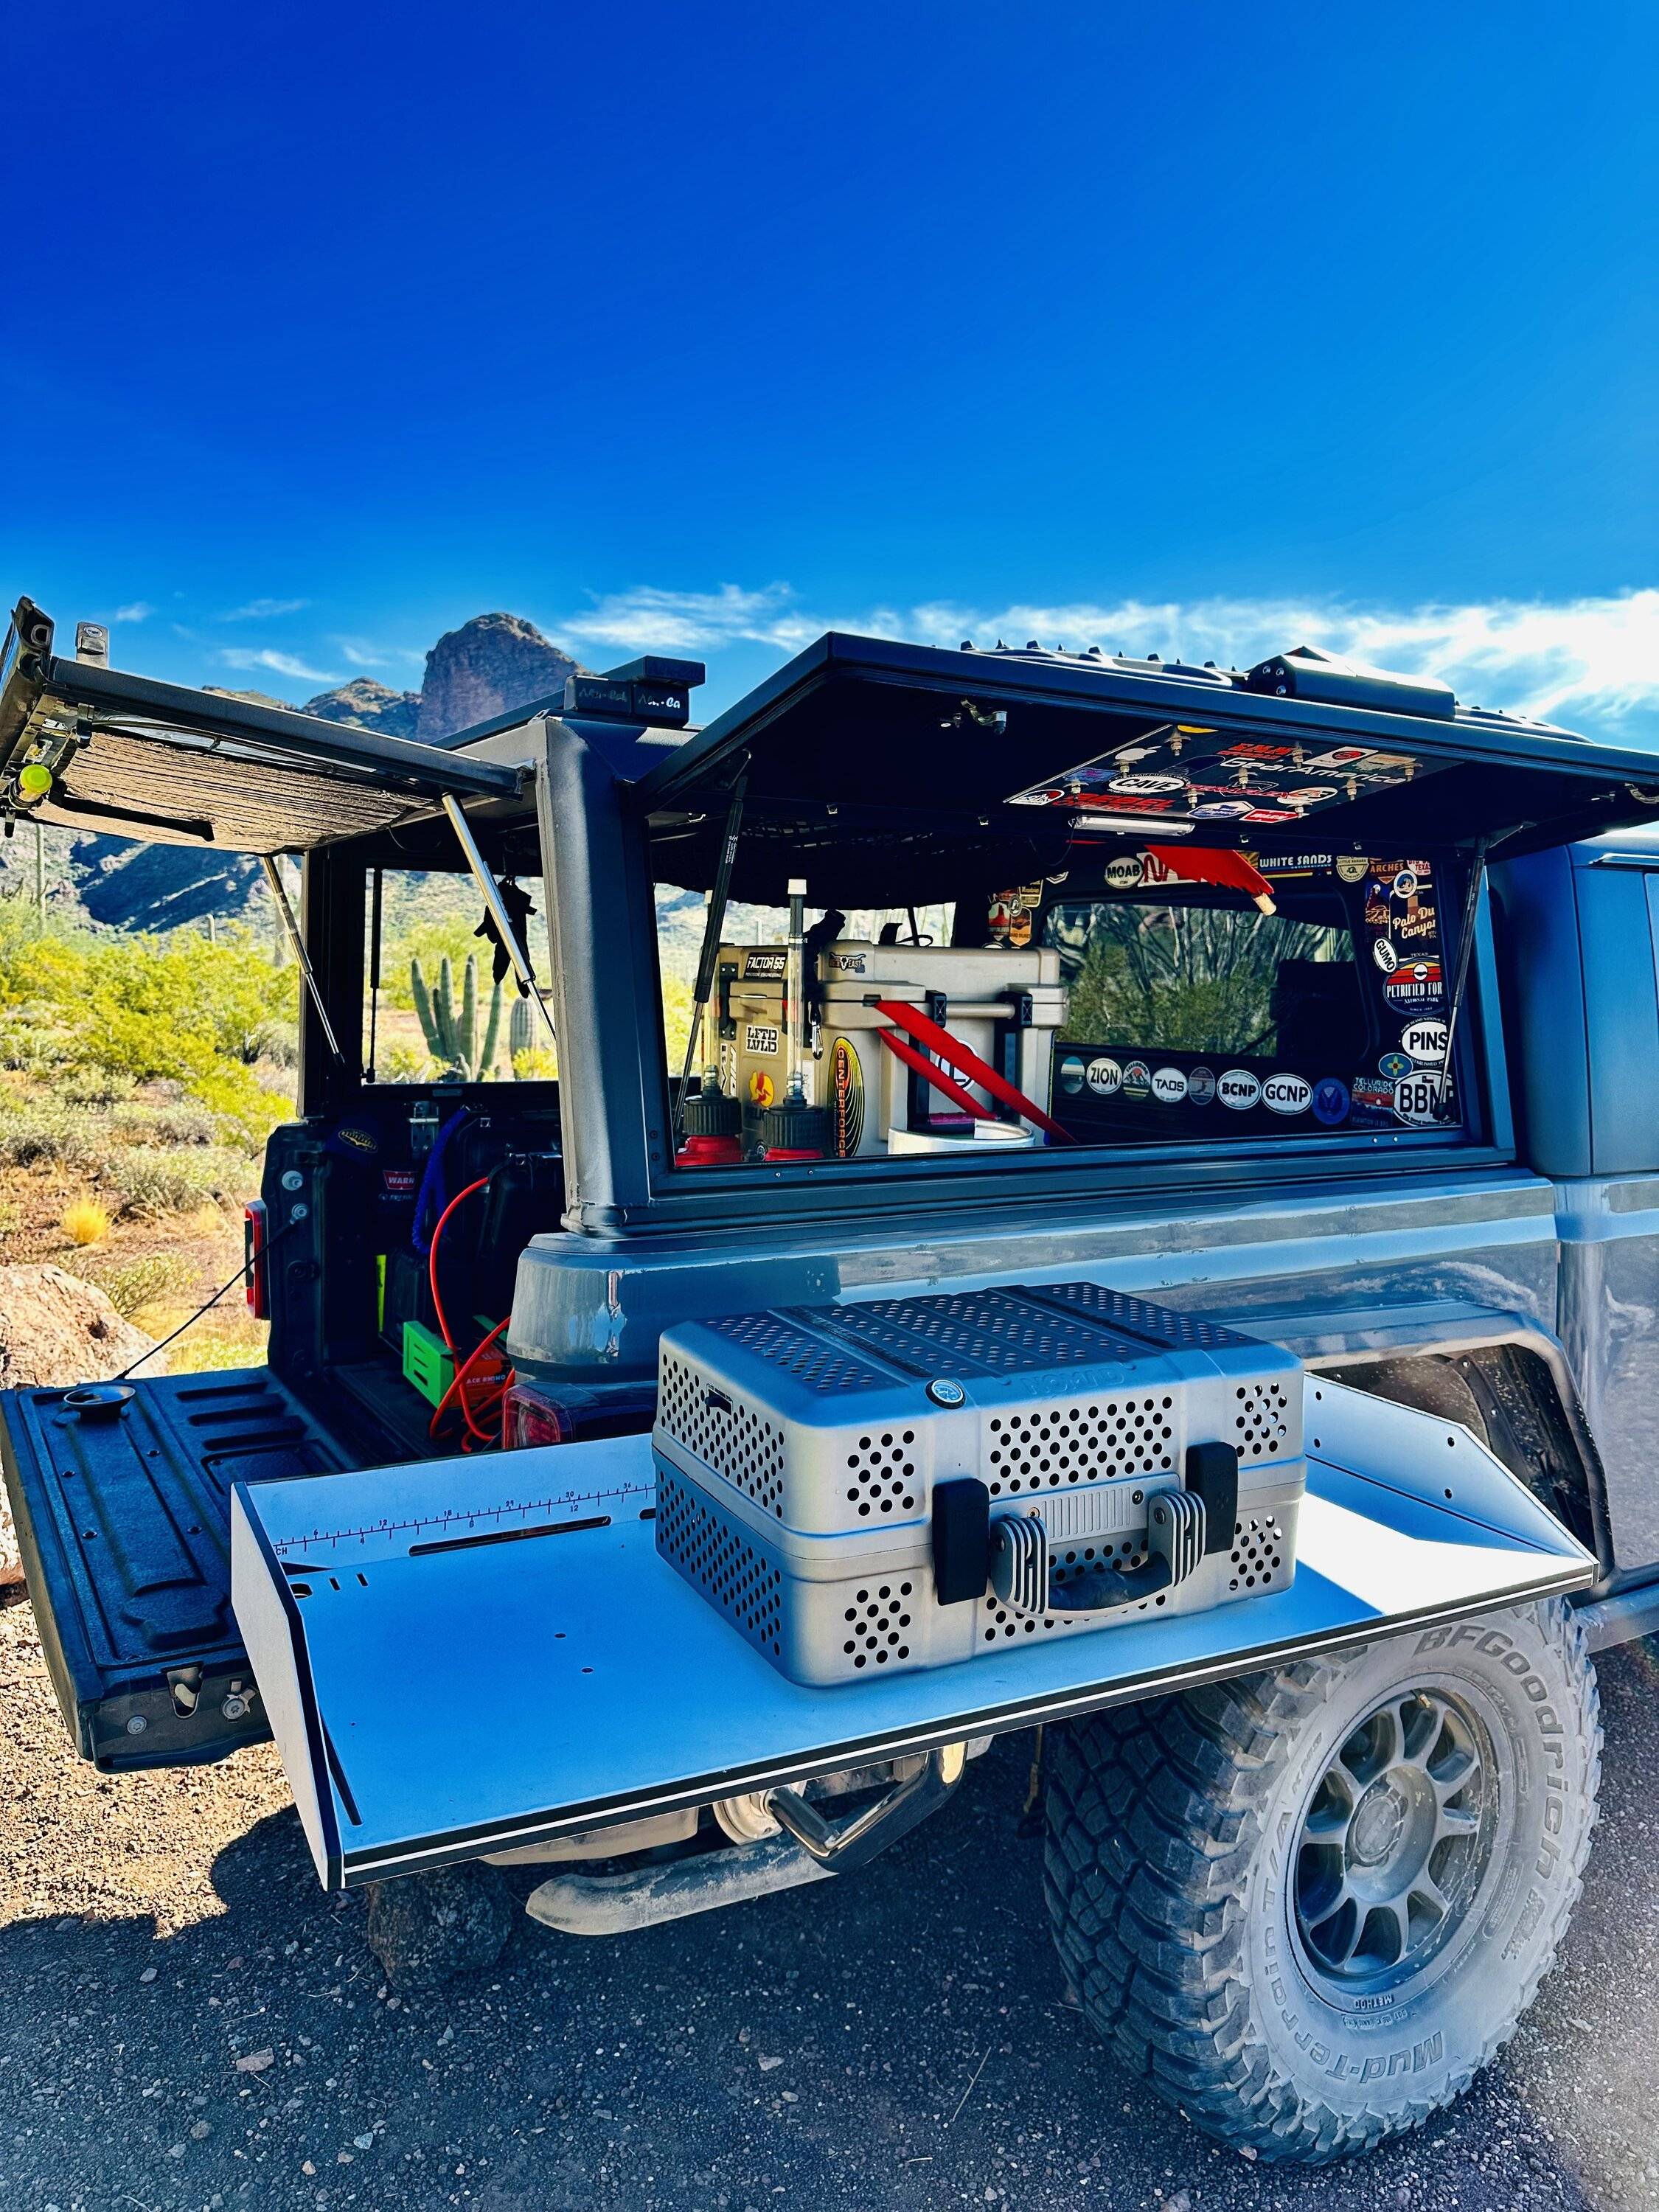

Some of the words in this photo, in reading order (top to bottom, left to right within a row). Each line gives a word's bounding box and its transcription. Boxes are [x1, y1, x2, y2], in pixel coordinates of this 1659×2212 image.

[1220, 757, 1408, 784] GearAmerica
[1116, 778, 1179, 791] CAVE
[1259, 857, 1294, 868] WHITE
[1297, 855, 1332, 865] SANDS
[1370, 863, 1404, 873] ARCHES
[1107, 864, 1140, 879] MOAB
[1392, 914, 1416, 930] Palo
[1376, 939, 1395, 971] GUMO
[747, 957, 773, 970] FACTOR
[773, 957, 786, 970] 55
[1387, 983, 1425, 998] PETRIFIED
[1428, 981, 1442, 995] FOR
[747, 1026, 778, 1041] LFTD
[747, 1039, 777, 1053] LVLD
[1409, 1032, 1450, 1051] PINS
[1090, 1067, 1118, 1086] ZION
[1355, 1077, 1394, 1087] TELLURIDE
[1155, 1078, 1184, 1092] TAOS
[1221, 1082, 1256, 1097] BCNP
[1354, 1084, 1394, 1094] COLORADO
[1265, 1083, 1309, 1103] GCNP
[838, 1048, 846, 1157] CENTERFORCE
[276, 1547, 288, 1555] CH
[1411, 1624, 1564, 1880] BFGoodrich
[1264, 1926, 1444, 2084] Mud-Terrain
[1354, 1994, 1395, 2010] METHOD
